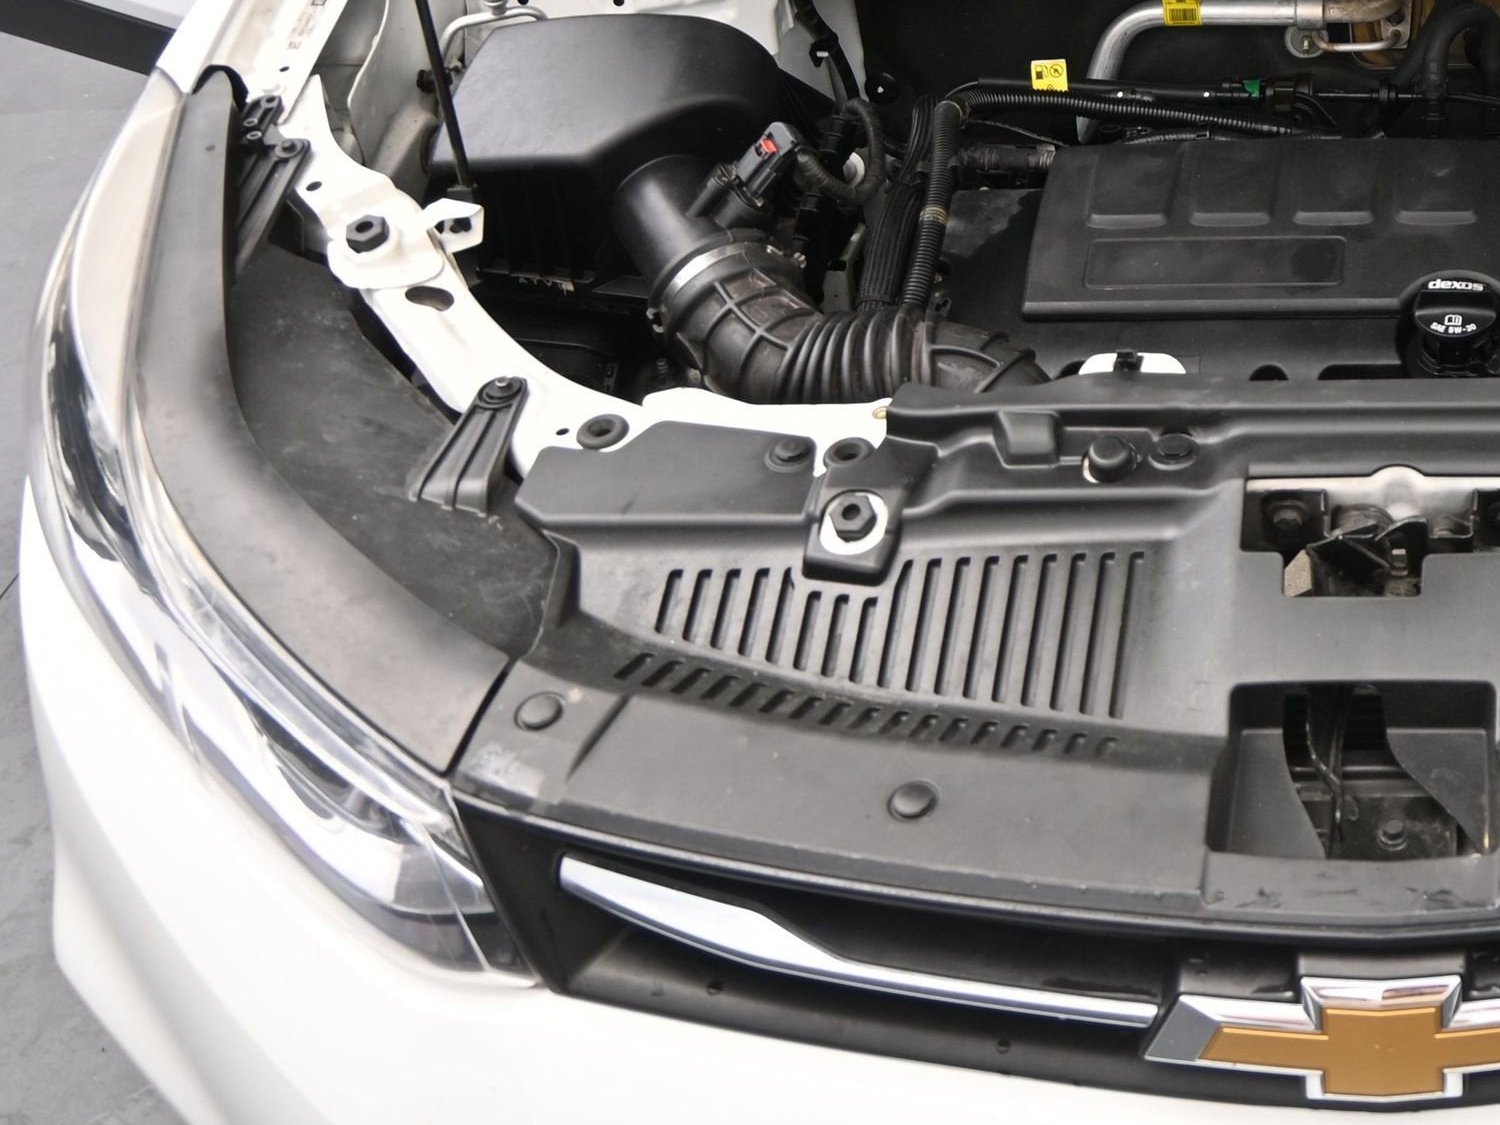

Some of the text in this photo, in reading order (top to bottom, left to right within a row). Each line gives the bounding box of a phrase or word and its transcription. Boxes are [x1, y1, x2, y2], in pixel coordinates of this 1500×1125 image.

[1428, 279, 1484, 291] dexos
[1430, 322, 1477, 334] SAE 5W-30
